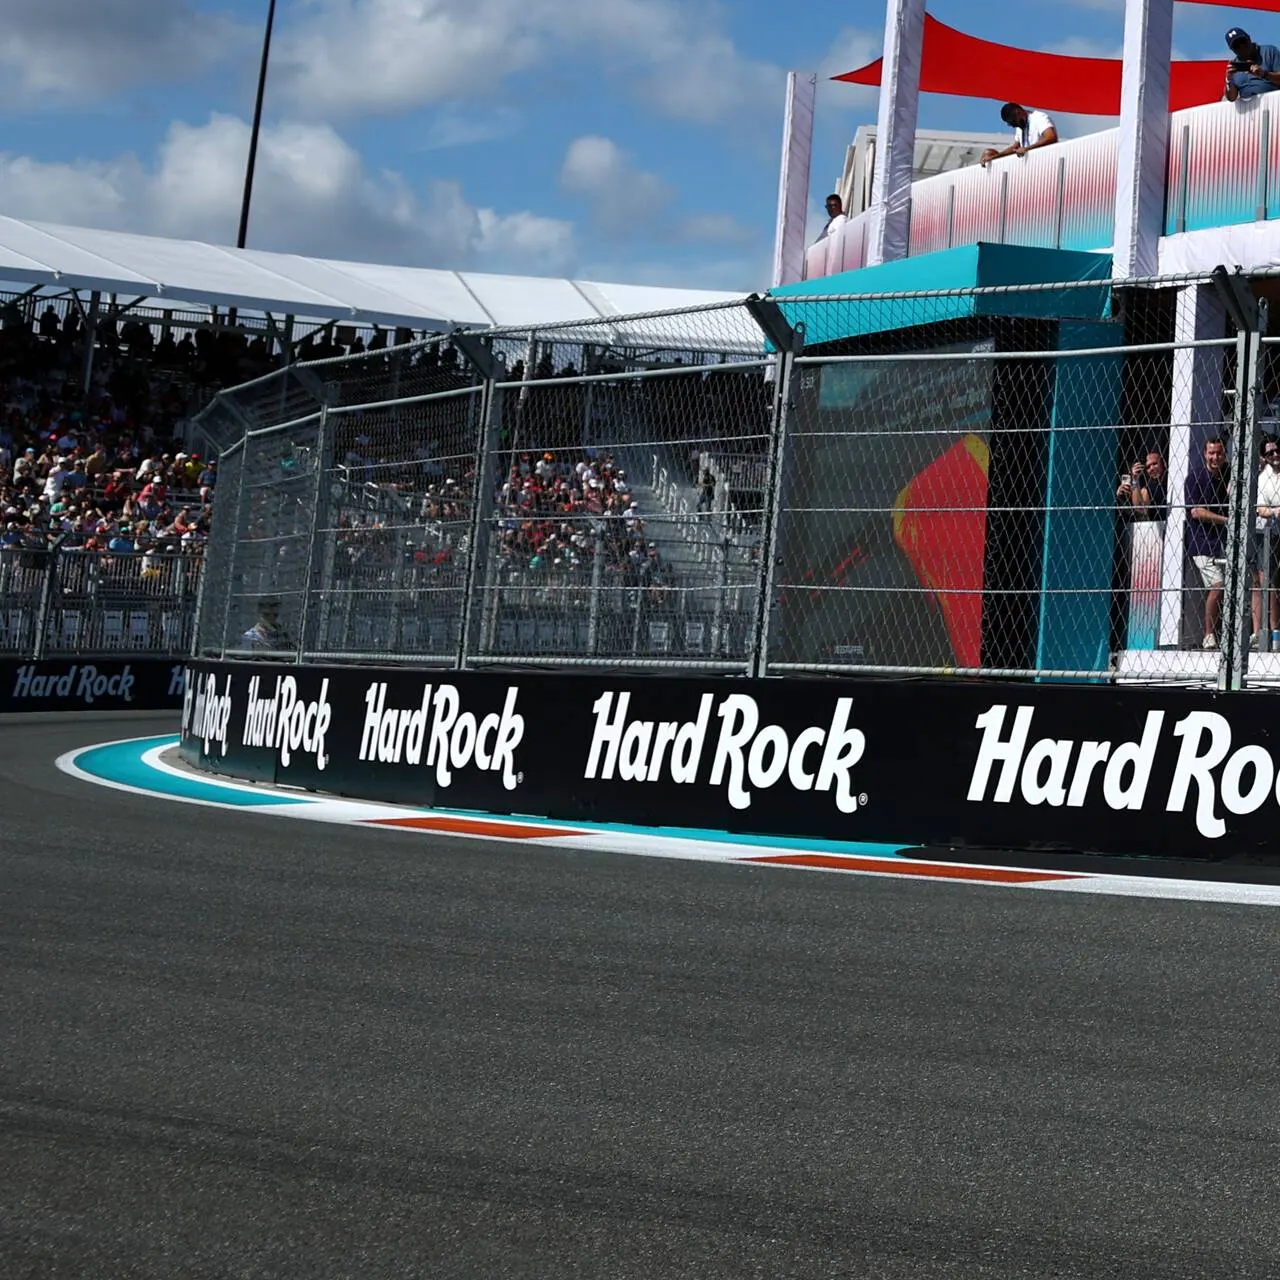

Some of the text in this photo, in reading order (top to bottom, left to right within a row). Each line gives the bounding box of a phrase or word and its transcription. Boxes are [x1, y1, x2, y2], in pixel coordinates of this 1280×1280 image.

[12, 665, 79, 697] Hard
[76, 664, 136, 703] Rock
[243, 675, 281, 747] Hard
[275, 675, 331, 770] Rock
[359, 683, 525, 790] Hard Rock
[584, 691, 866, 813] Hard Rock
[967, 705, 1165, 810] Hard
